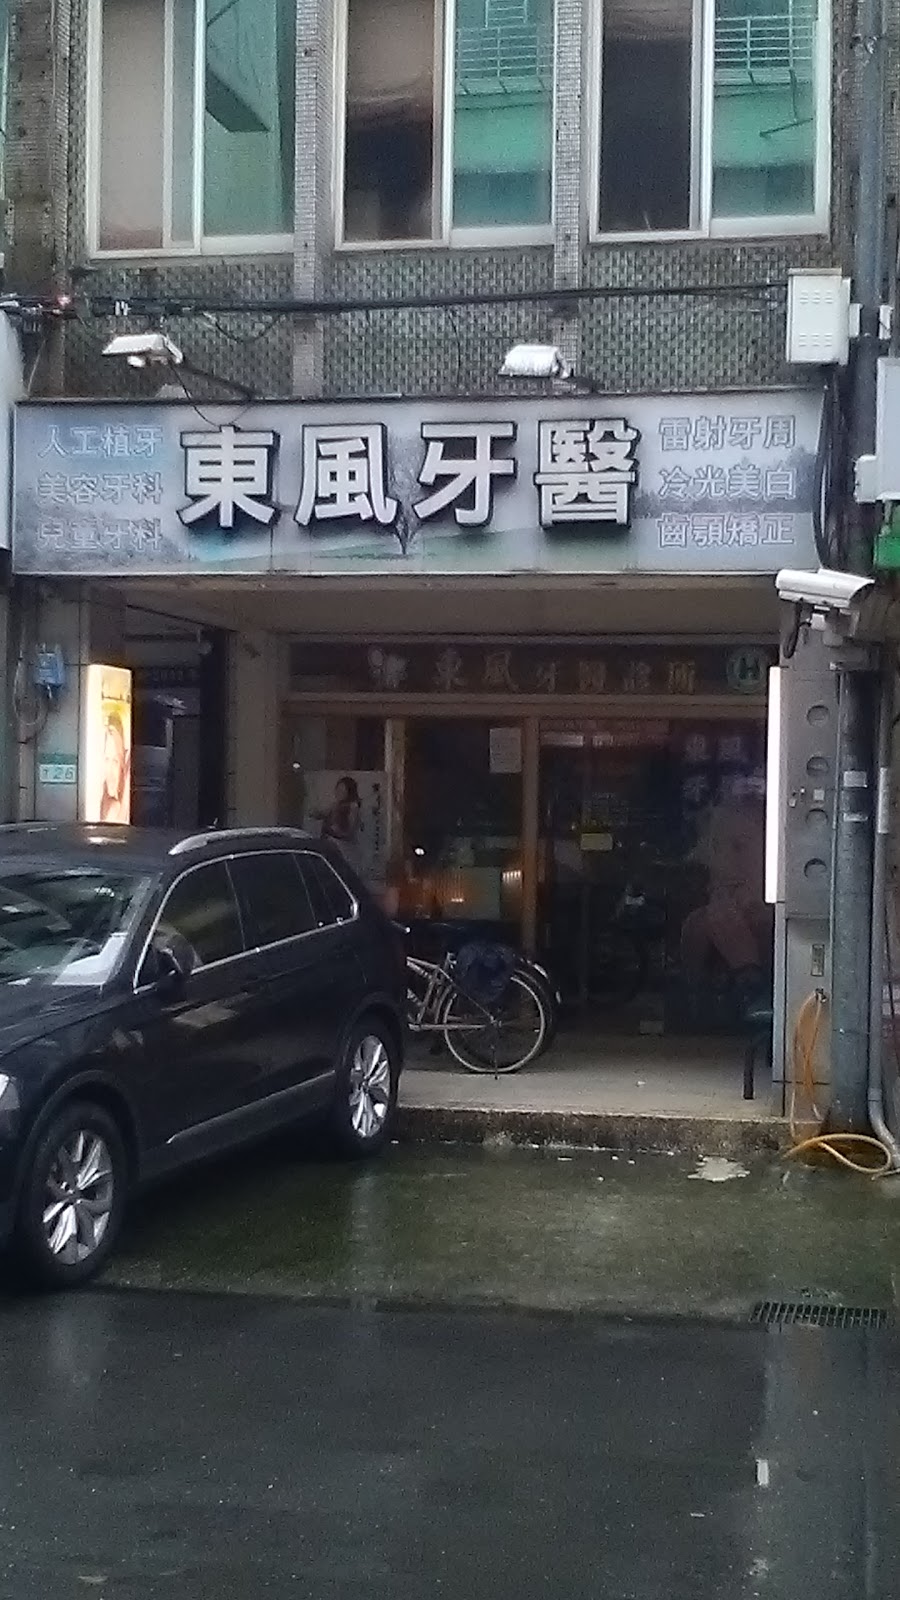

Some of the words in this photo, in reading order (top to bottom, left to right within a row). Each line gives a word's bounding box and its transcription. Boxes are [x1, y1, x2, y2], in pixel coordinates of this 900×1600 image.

[38, 424, 163, 458] 人工植牙
[659, 415, 796, 451] 雷射牙周
[37, 472, 163, 504] 美容牙科
[177, 418, 641, 528] 東風牙醫
[659, 464, 797, 500] 冷光美白
[37, 516, 163, 551] 兒童牙科
[657, 513, 795, 547] 齒顎矯正
